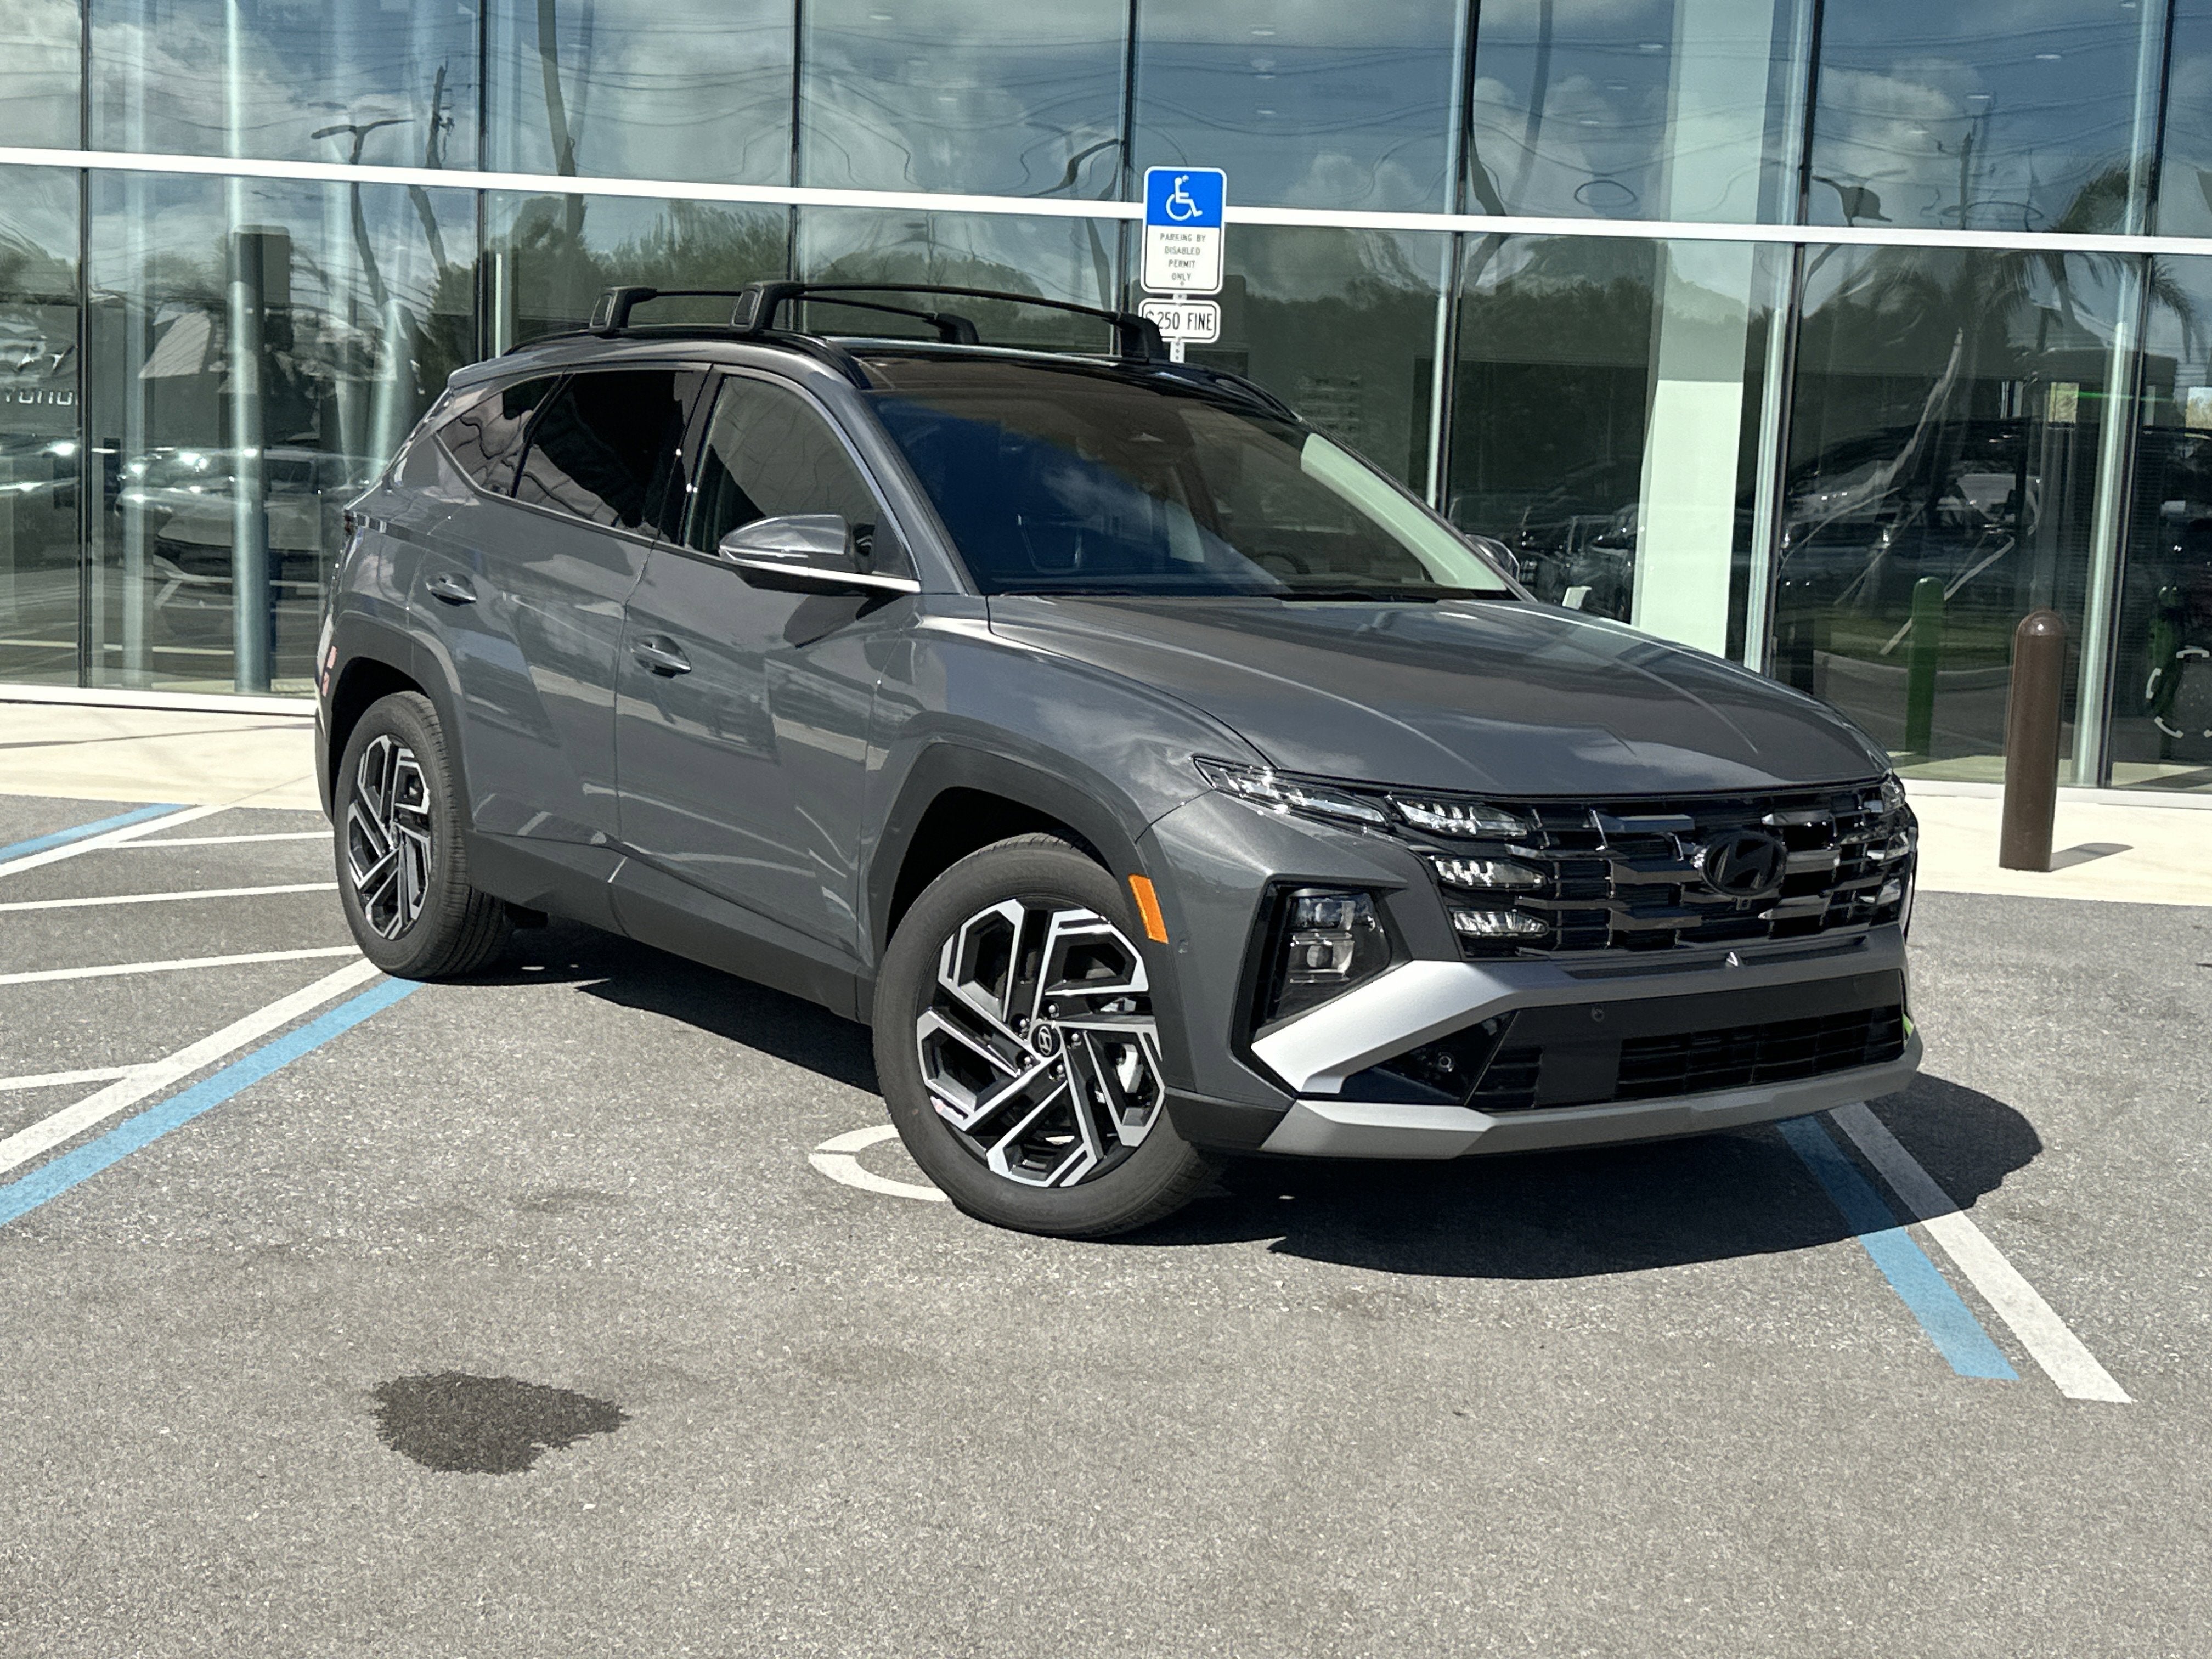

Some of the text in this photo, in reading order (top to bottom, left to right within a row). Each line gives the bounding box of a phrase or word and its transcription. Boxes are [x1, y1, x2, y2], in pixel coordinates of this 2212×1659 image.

[1160, 233, 1206, 242] PARKING BY
[1165, 246, 1200, 255] DISABLED
[1168, 259, 1195, 268] PERMIT
[1171, 272, 1192, 281] ONLY
[1187, 312, 1212, 330] FINE
